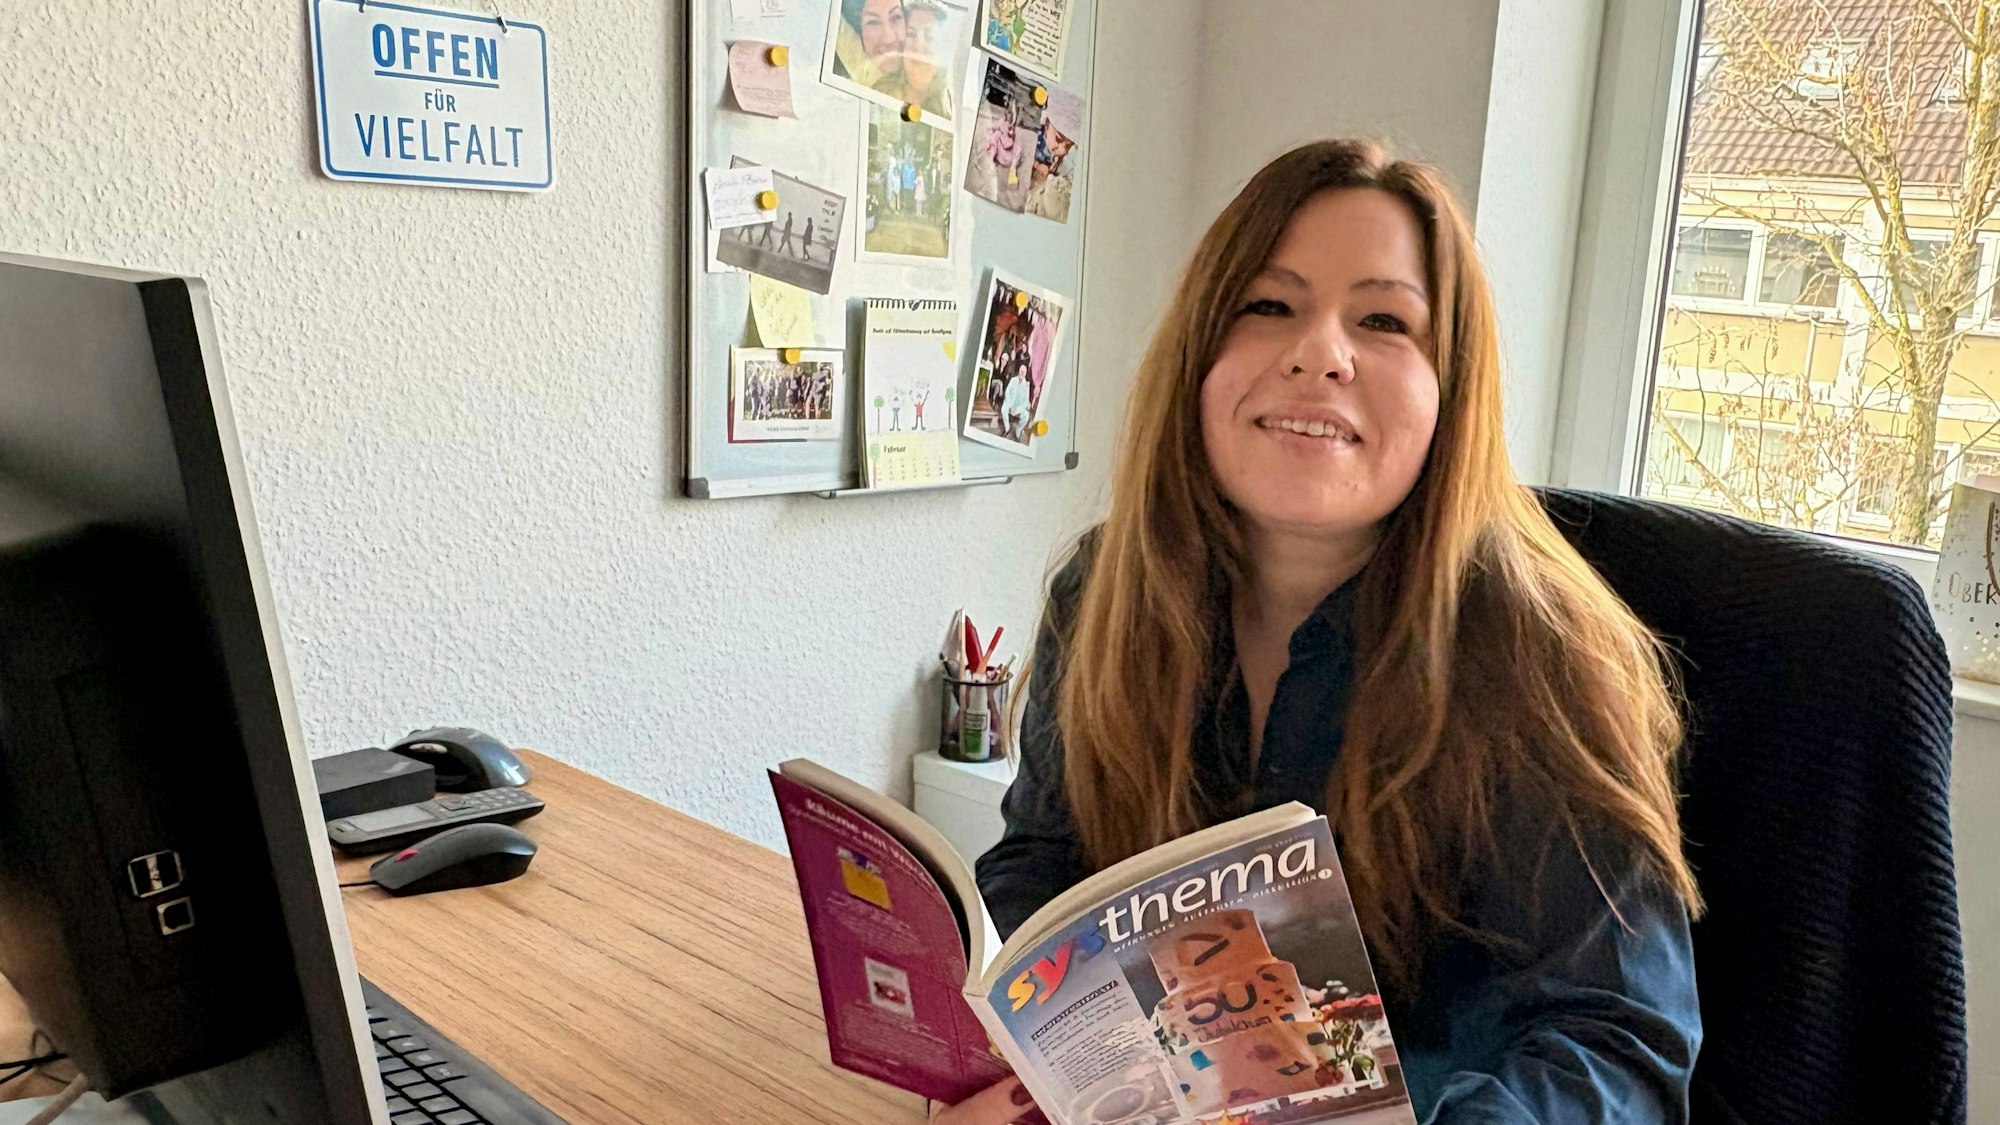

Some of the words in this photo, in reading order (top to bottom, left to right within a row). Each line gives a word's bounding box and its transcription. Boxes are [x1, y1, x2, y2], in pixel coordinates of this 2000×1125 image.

[372, 24, 499, 80] OFFEN
[424, 89, 457, 112] FÜR
[355, 113, 523, 168] VIELFALT
